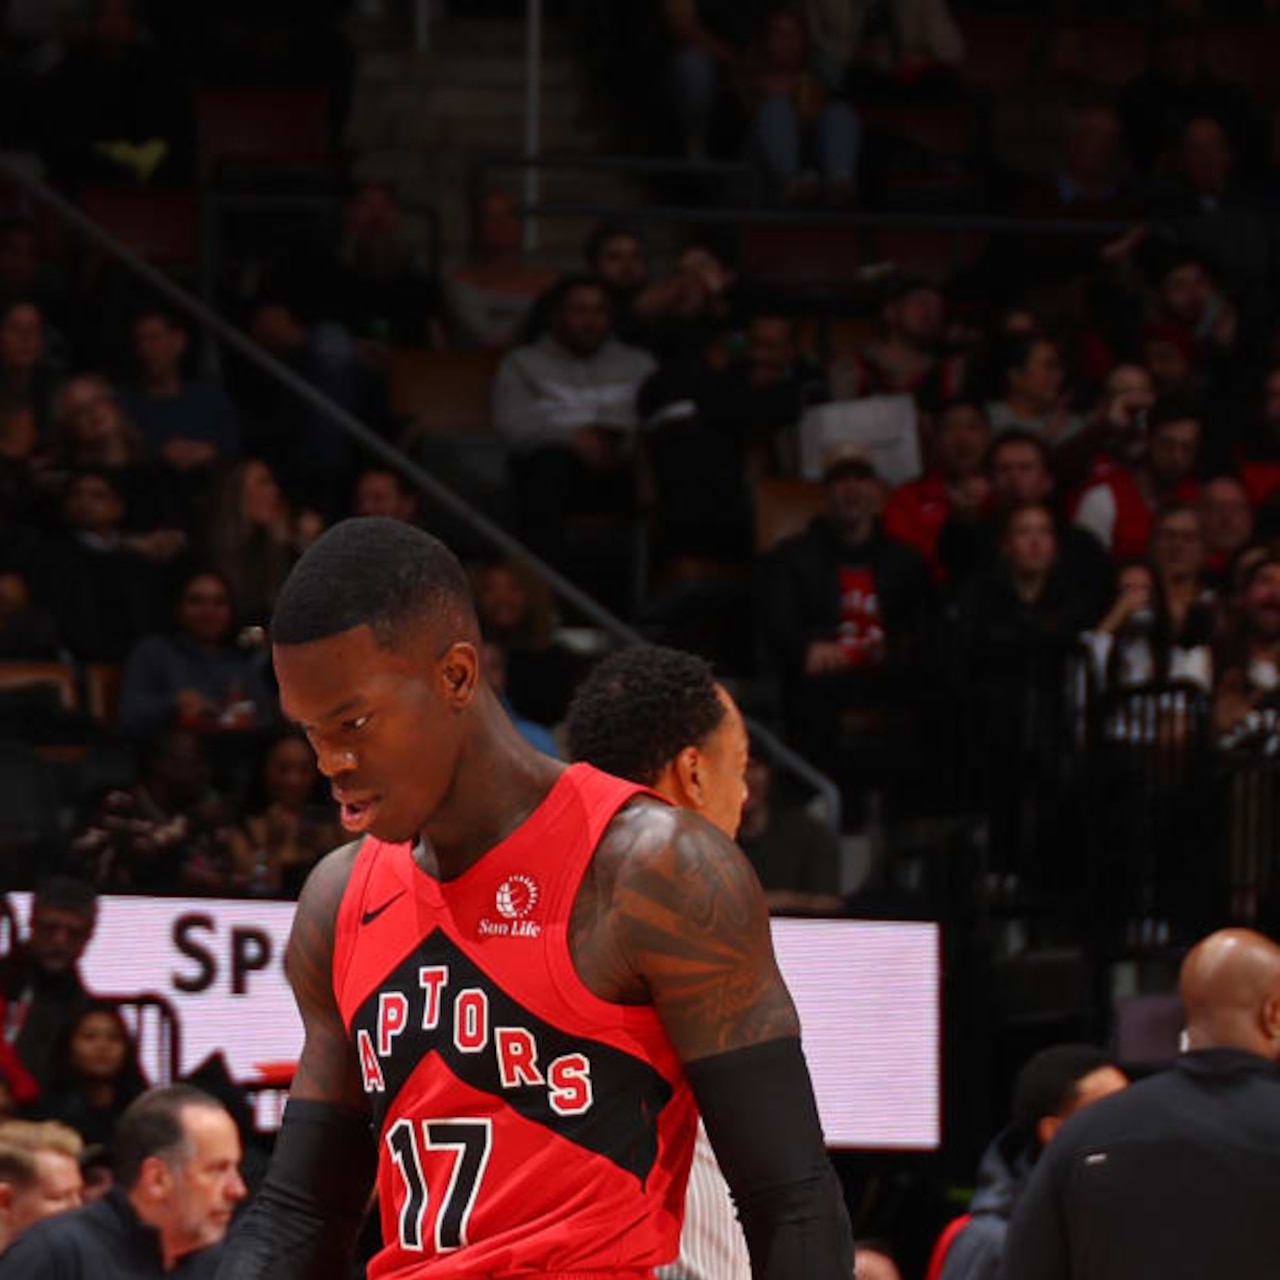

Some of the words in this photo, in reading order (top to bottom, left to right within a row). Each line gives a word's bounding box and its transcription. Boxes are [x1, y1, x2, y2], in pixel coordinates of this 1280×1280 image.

[478, 918, 509, 936] Sun
[510, 920, 541, 938] Life
[357, 965, 592, 1116] APTORS
[385, 1117, 492, 1253] 17
